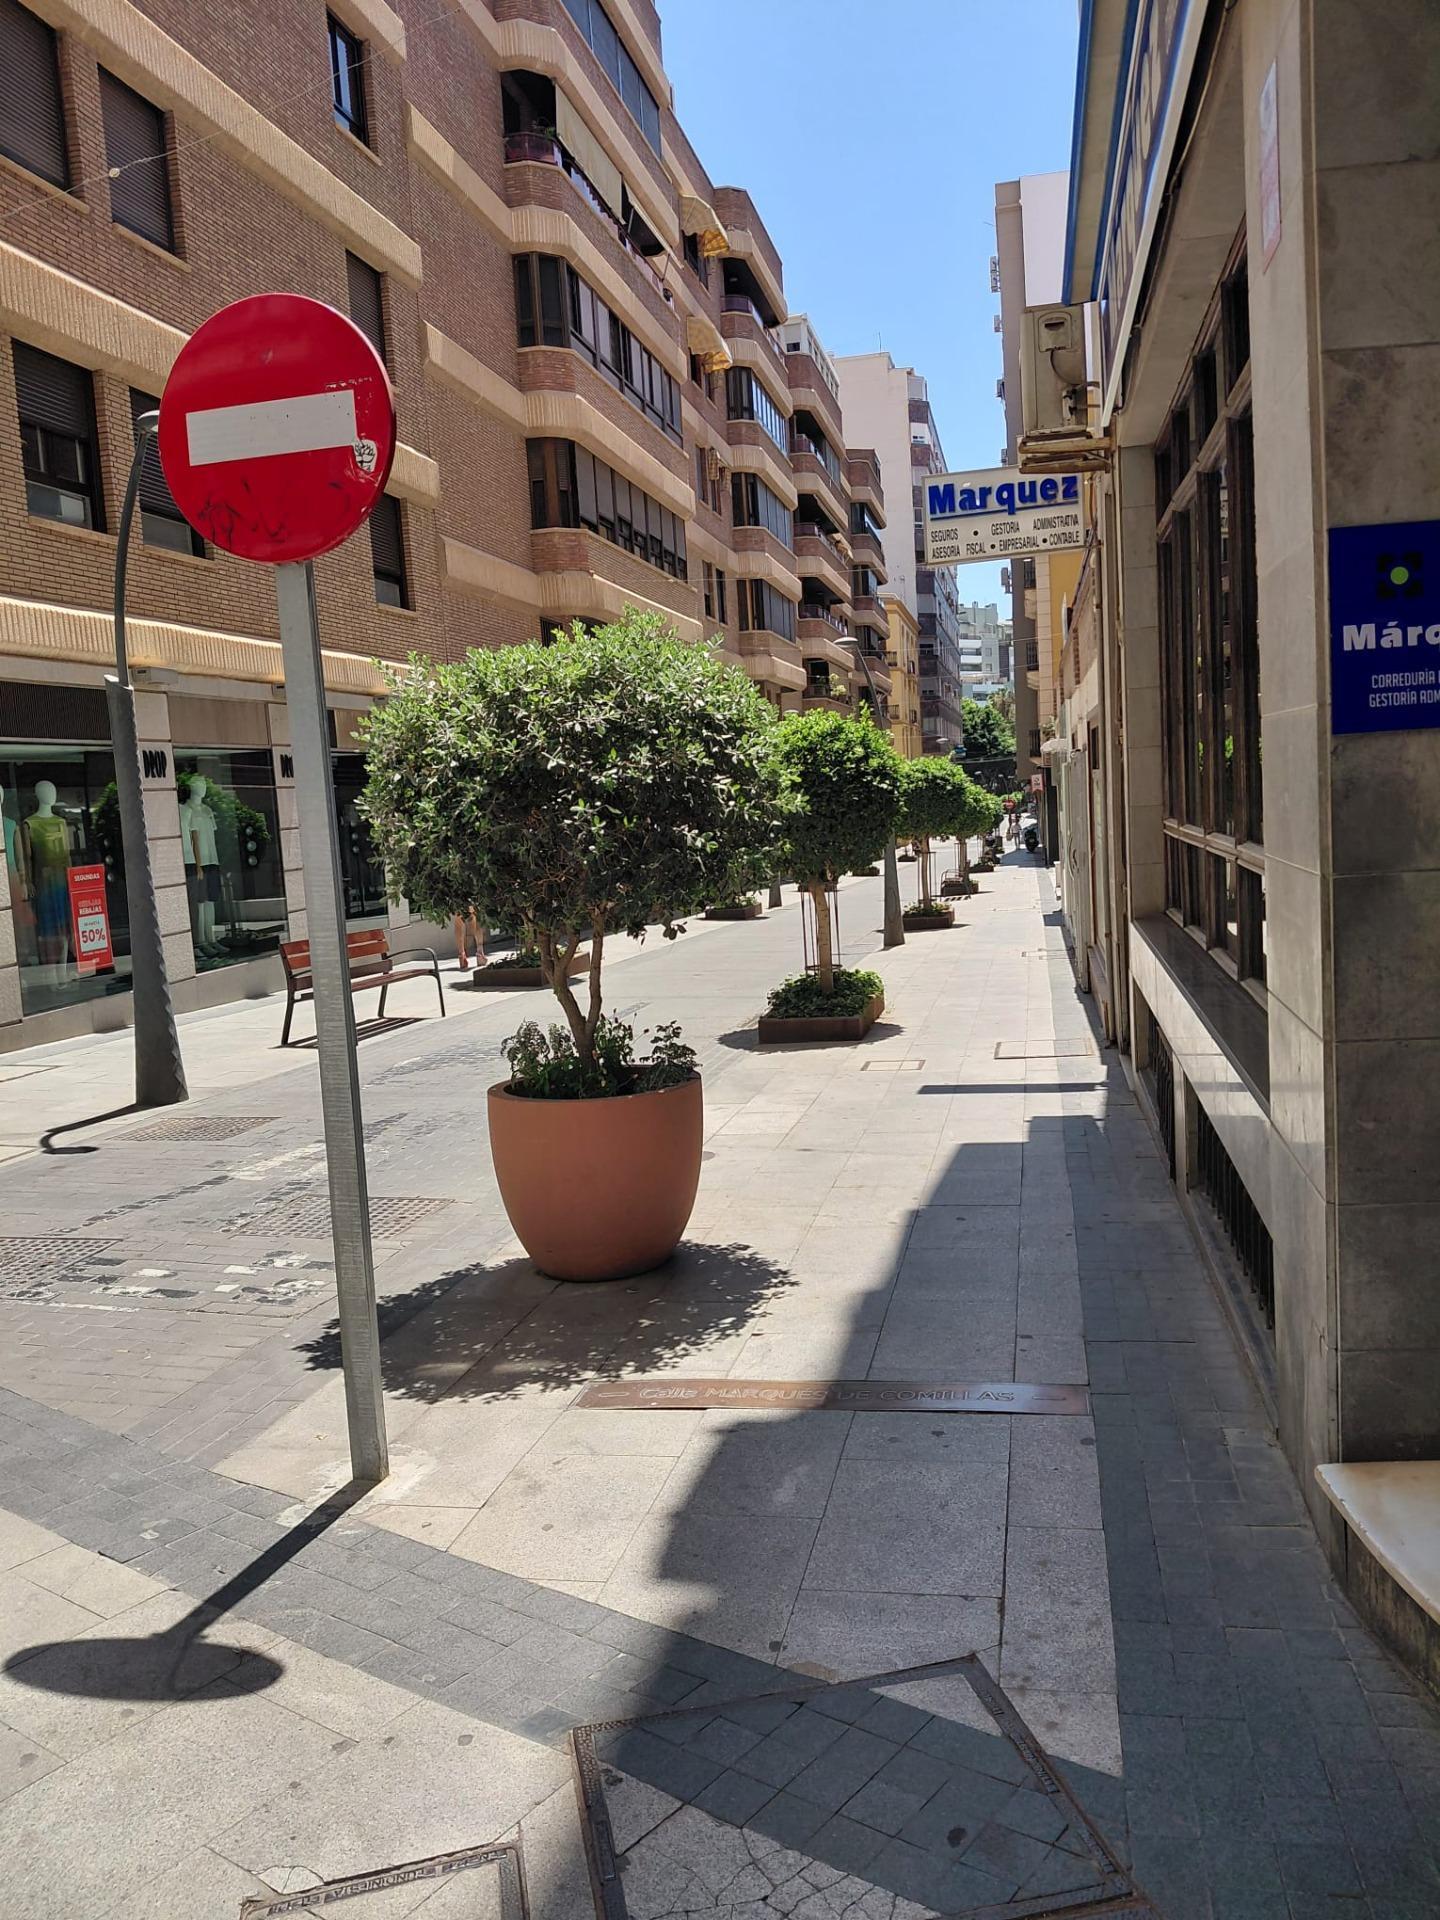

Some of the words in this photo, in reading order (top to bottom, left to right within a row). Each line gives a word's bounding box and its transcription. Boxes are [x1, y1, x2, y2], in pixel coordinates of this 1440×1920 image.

[930, 528, 959, 543] SEGUROS
[991, 521, 1020, 536] GESTORIA
[1033, 513, 1079, 531] ADMINISTRATIVA
[931, 545, 960, 560] ASESORIA
[966, 542, 986, 555] FISCAL
[999, 535, 1040, 552] EMPRESARIAL
[1049, 530, 1080, 546] CONTABLE
[143, 750, 167, 778] DROP
[81, 928, 105, 944] 50%
[837, 1390, 871, 1401] DE
[880, 1390, 1016, 1401] COMILLAS
